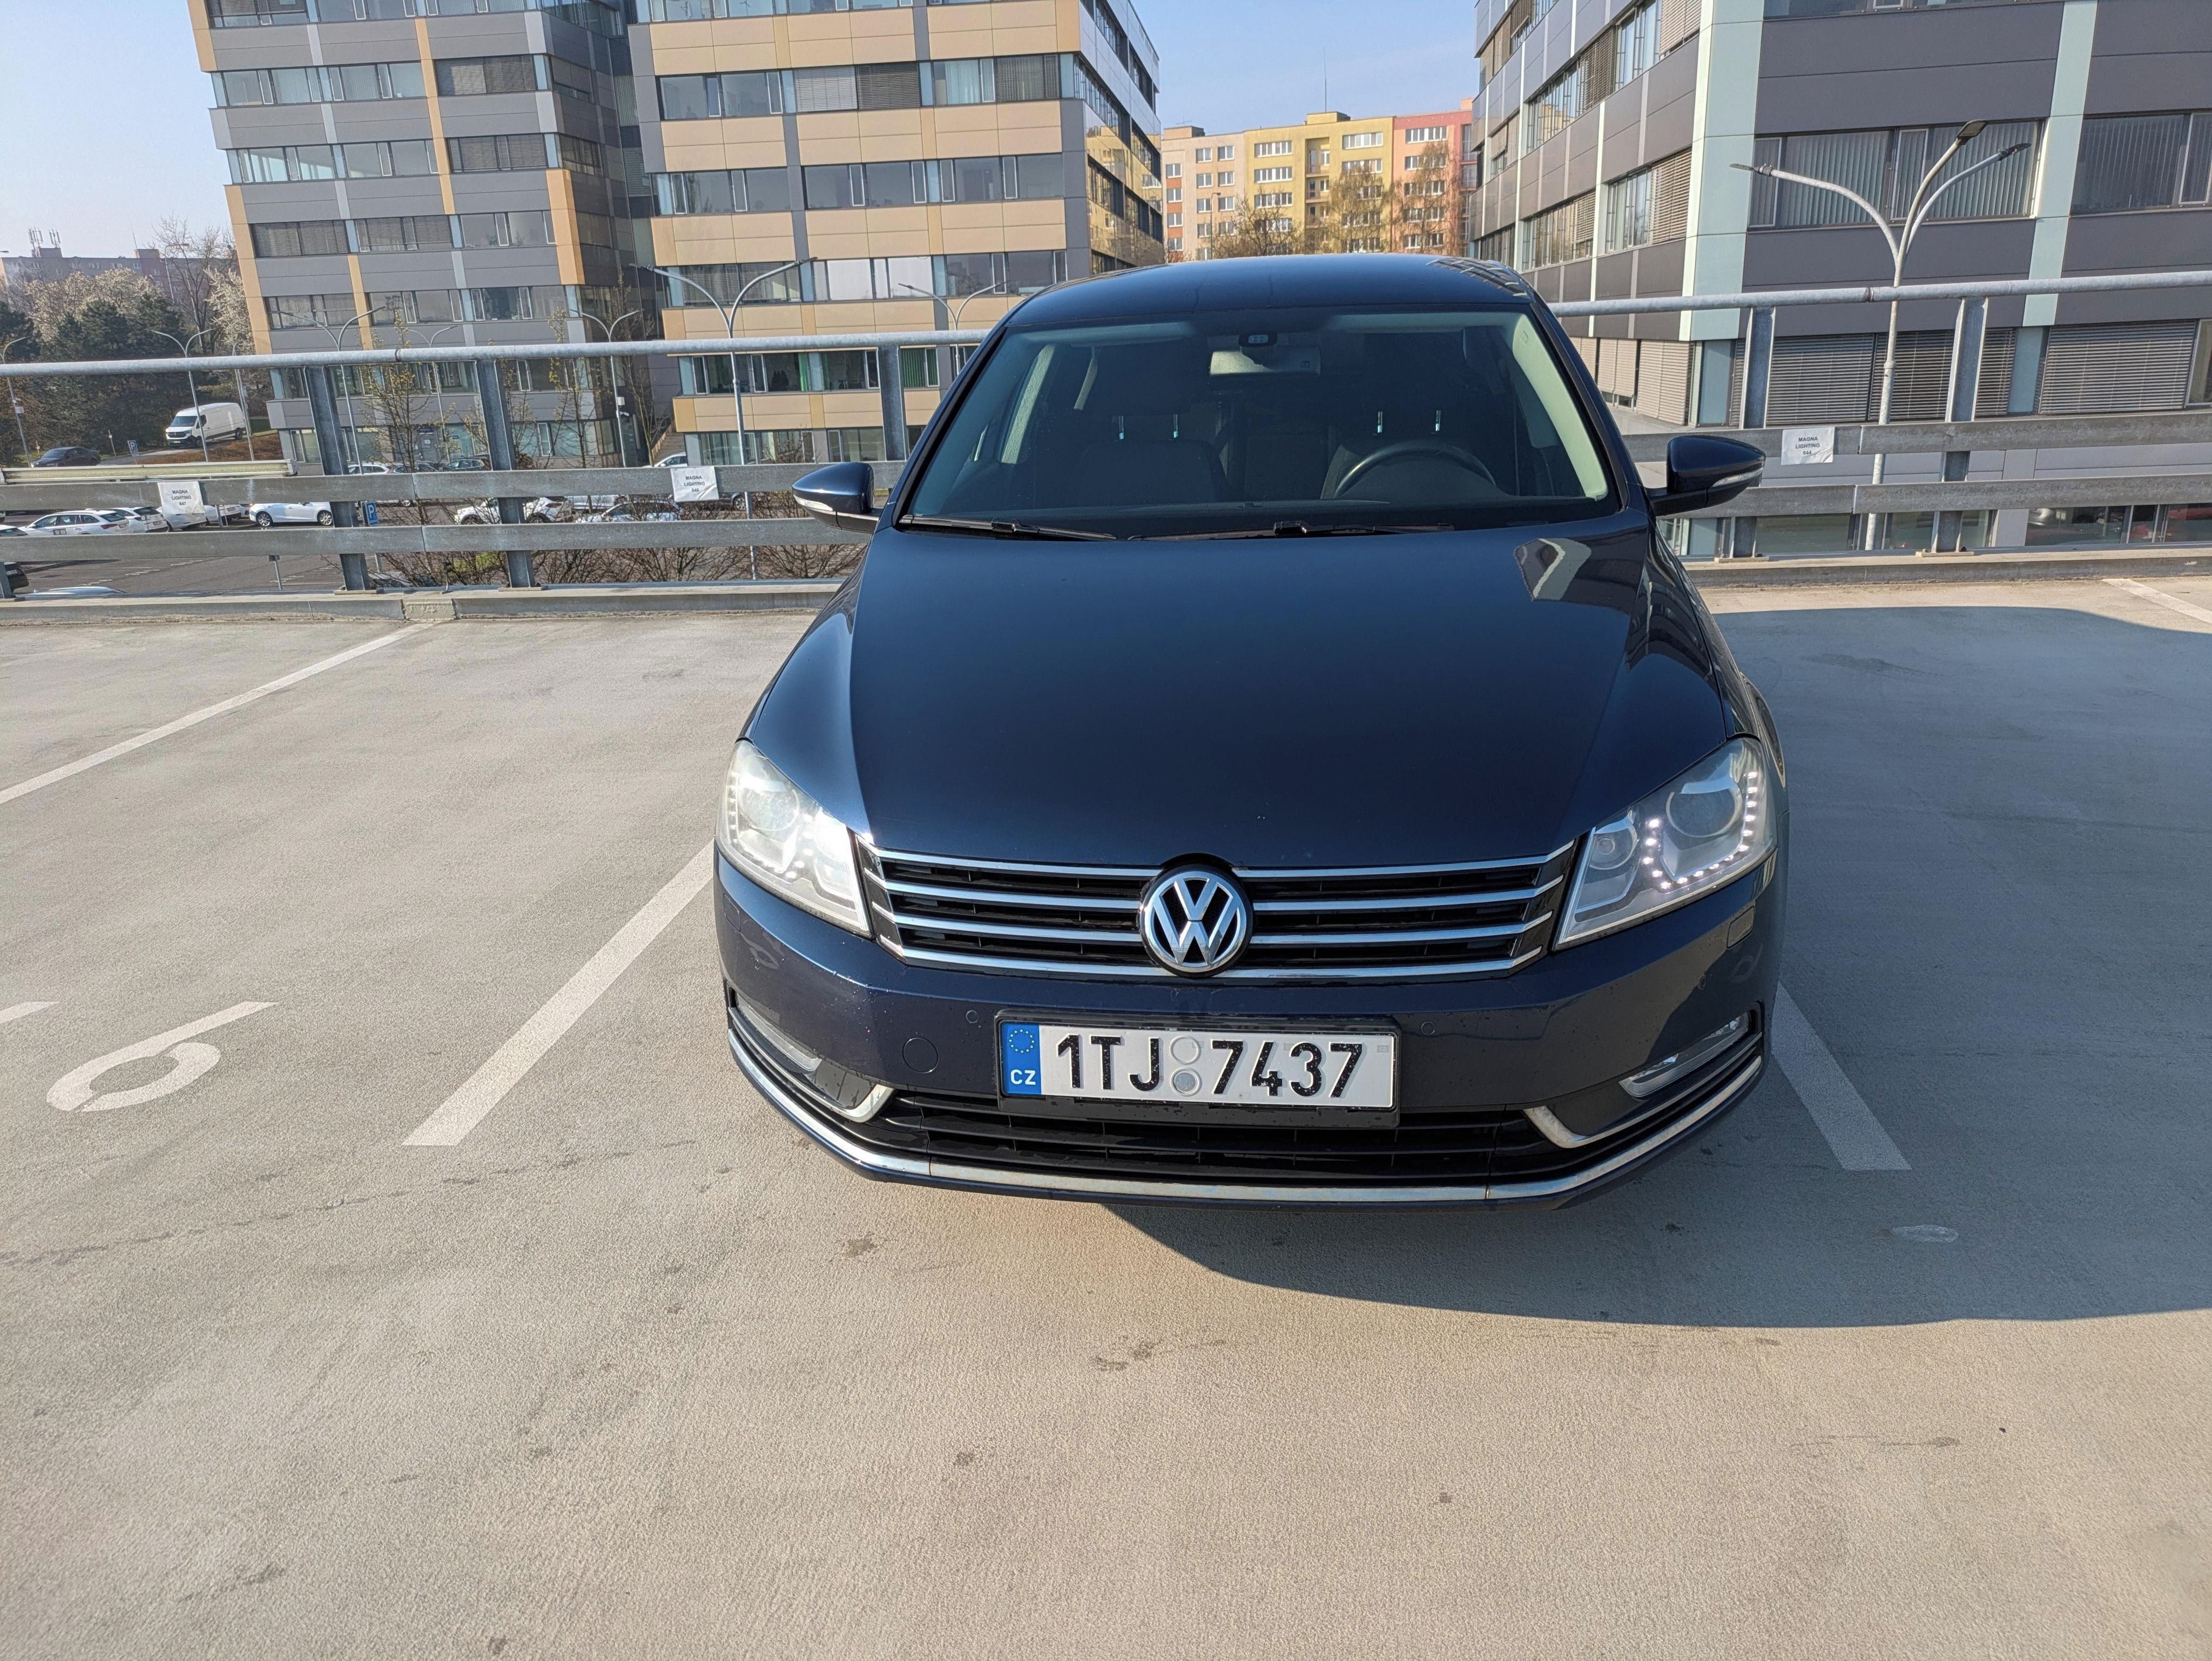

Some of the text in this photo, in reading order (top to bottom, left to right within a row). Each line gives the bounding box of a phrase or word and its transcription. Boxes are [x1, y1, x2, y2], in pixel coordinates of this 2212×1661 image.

[130, 442, 135, 450] P
[368, 505, 374, 518] P
[1057, 1035, 1365, 1098] 1TJ 7437
[1010, 1069, 1036, 1085] CZ
